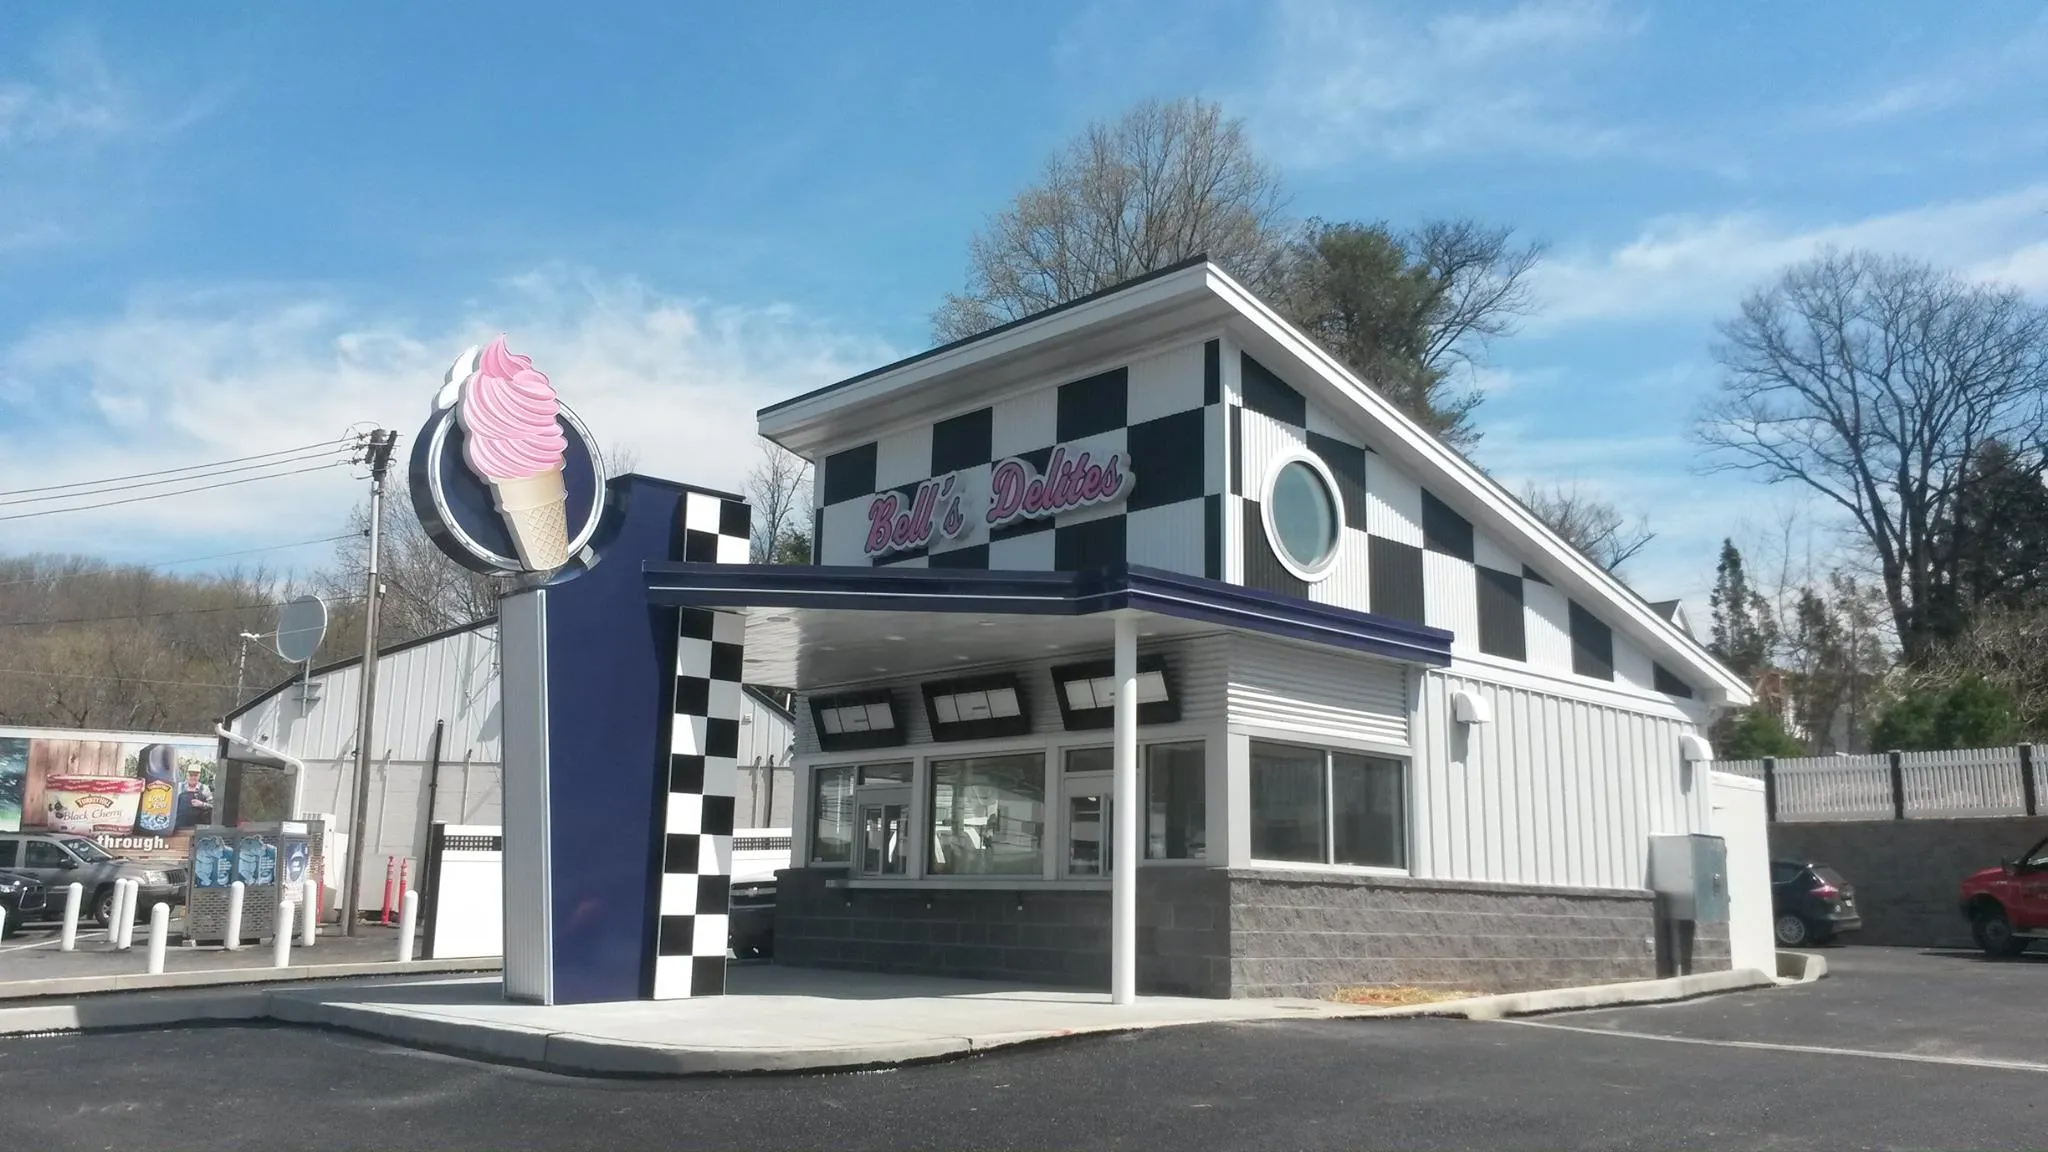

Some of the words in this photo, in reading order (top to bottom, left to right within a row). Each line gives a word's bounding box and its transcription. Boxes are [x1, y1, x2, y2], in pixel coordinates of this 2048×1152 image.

[865, 474, 963, 553] Bell's
[986, 447, 1123, 524] Delites
[63, 811, 89, 821] Black
[92, 808, 122, 820] Cherry
[97, 835, 169, 850] through.
